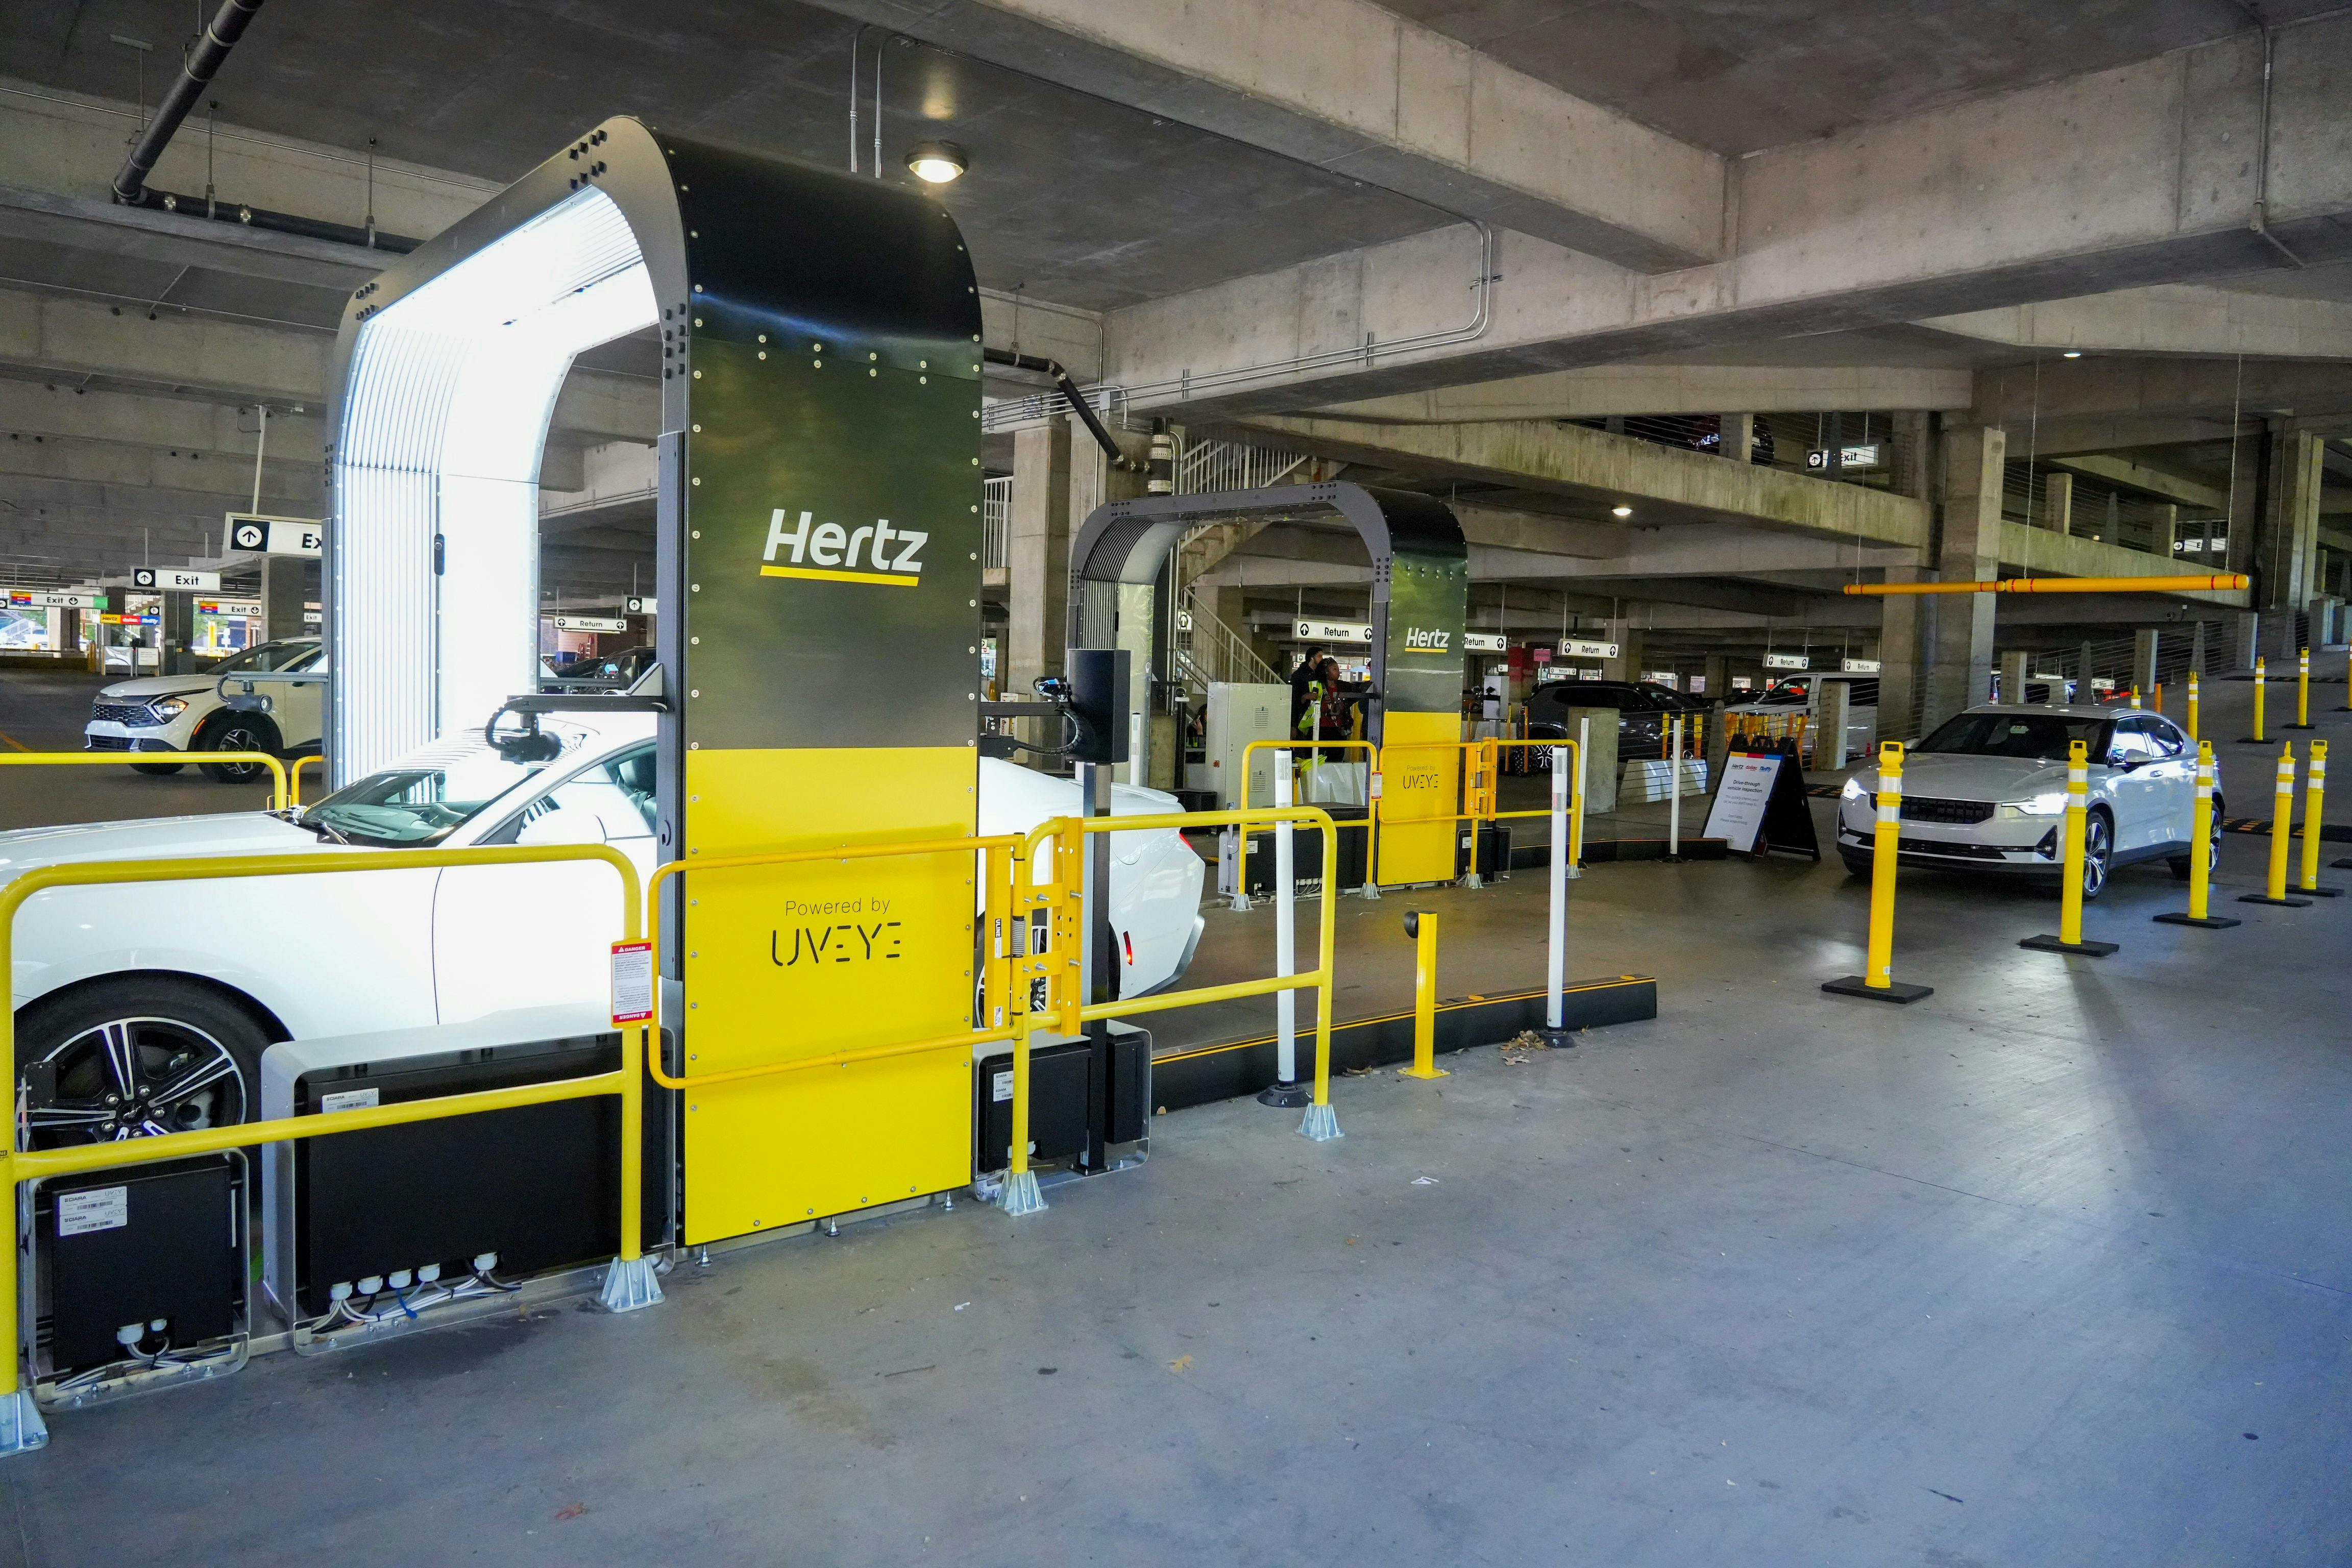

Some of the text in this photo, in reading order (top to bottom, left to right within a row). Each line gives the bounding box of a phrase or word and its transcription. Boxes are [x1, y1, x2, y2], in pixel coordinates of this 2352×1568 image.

[302, 533, 322, 549] Ex
[763, 508, 928, 572] Hertz
[176, 575, 199, 585] Exit
[1325, 627, 1349, 636] Return
[1406, 627, 1450, 648] Hertz
[1465, 637, 1484, 646] Return
[1582, 646, 1599, 654] Return
[1403, 774, 1438, 789] UVEYE
[785, 896, 891, 916] Powered by
[771, 922, 901, 966] UVEYE
